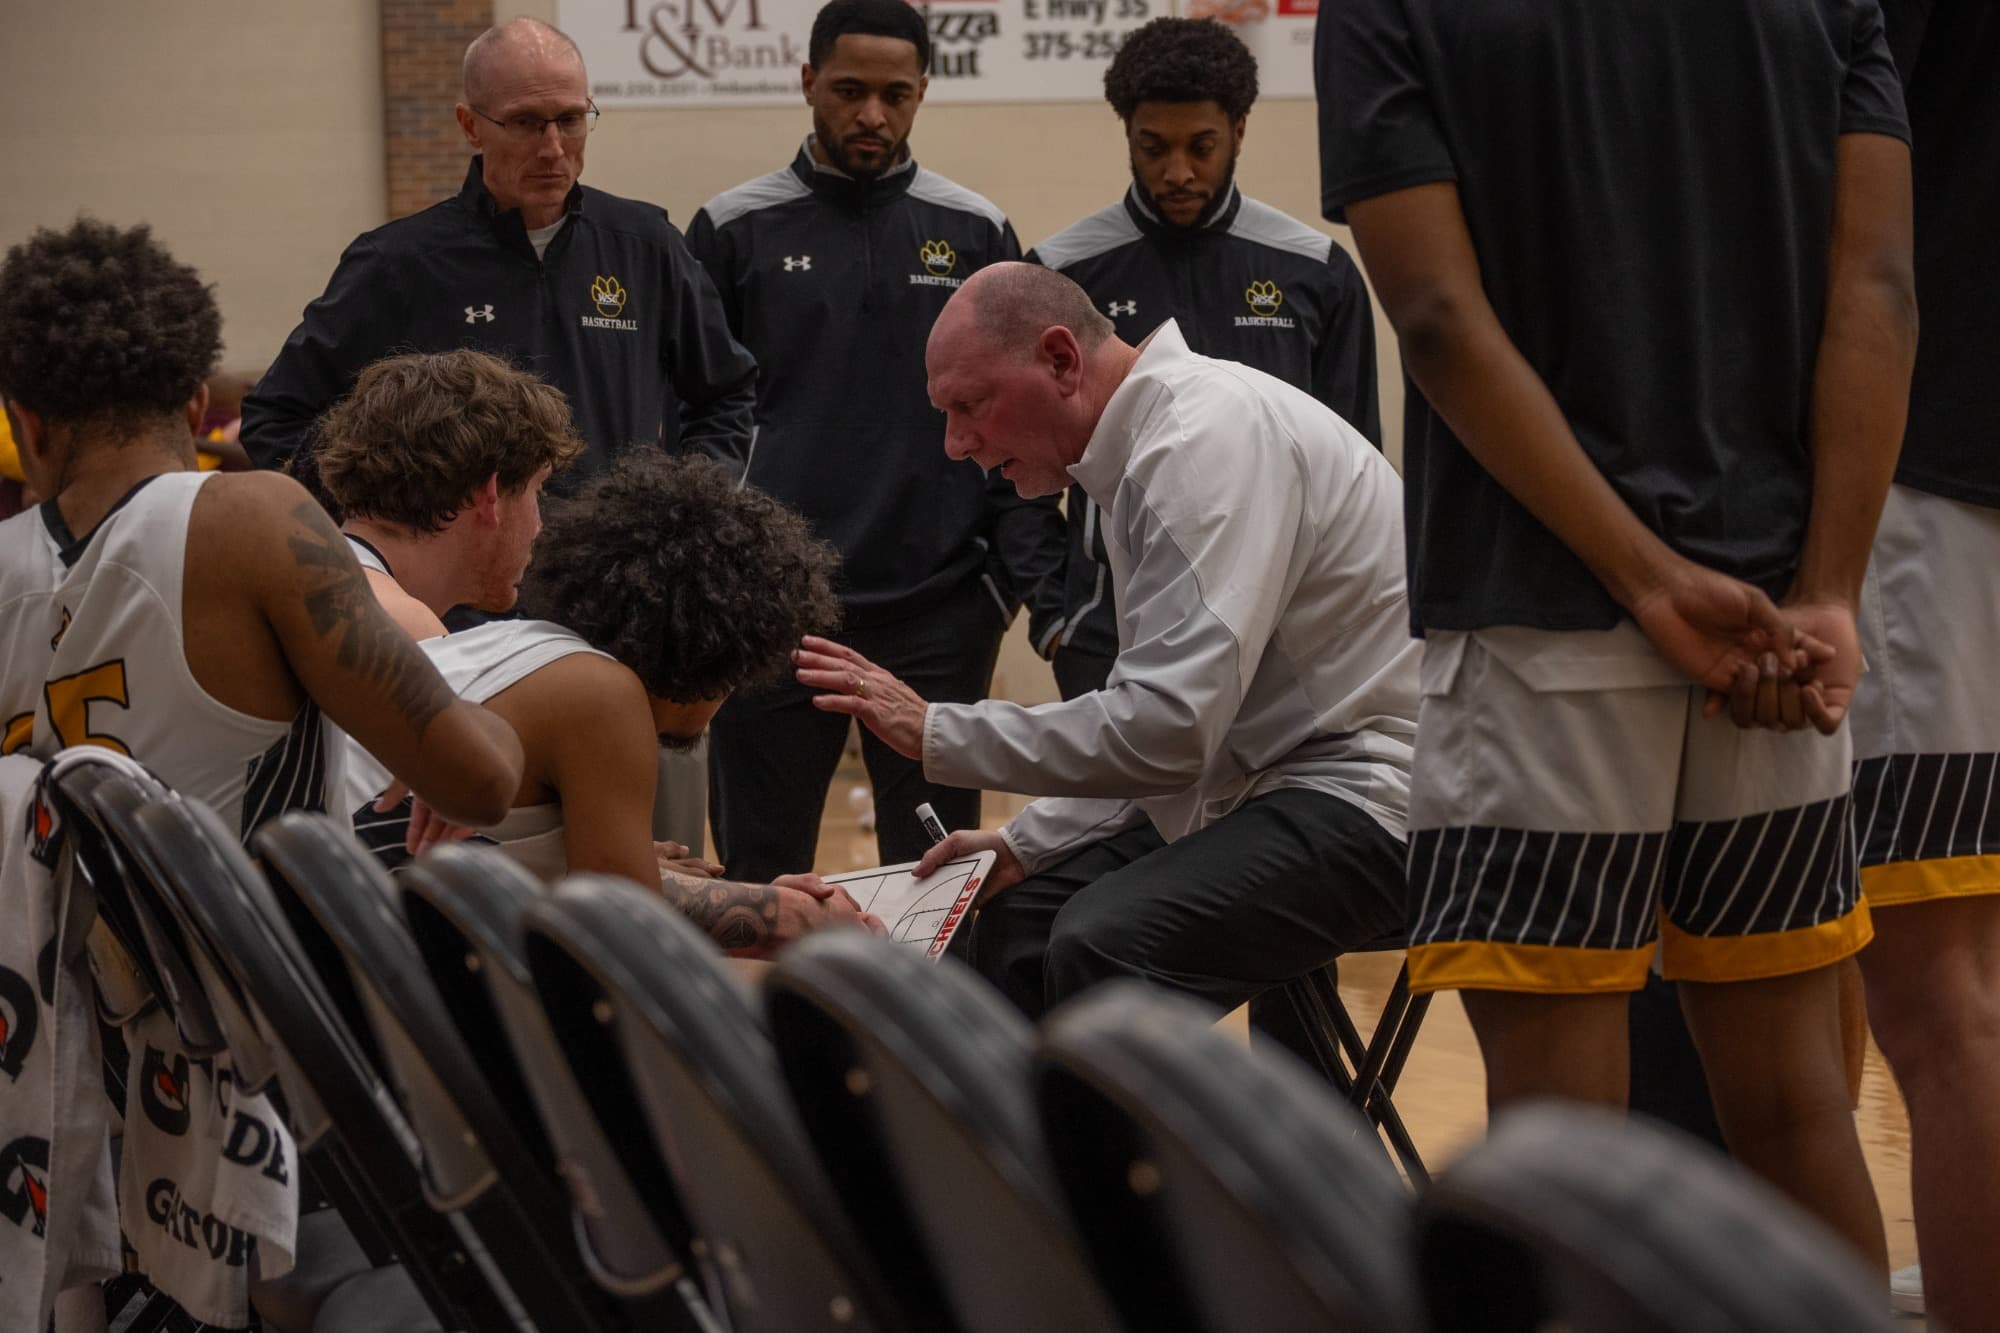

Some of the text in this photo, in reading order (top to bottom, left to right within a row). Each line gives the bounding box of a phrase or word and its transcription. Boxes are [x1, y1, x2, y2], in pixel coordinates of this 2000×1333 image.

[706, 33, 802, 68] Bank
[1023, 31, 1130, 59] 375-25
[909, 275, 965, 288] BASKETBAL
[581, 316, 638, 330] BASKETBALL
[1234, 316, 1295, 328] BASKETBALL
[45, 658, 134, 757] 5
[928, 877, 981, 956] CHEELS
